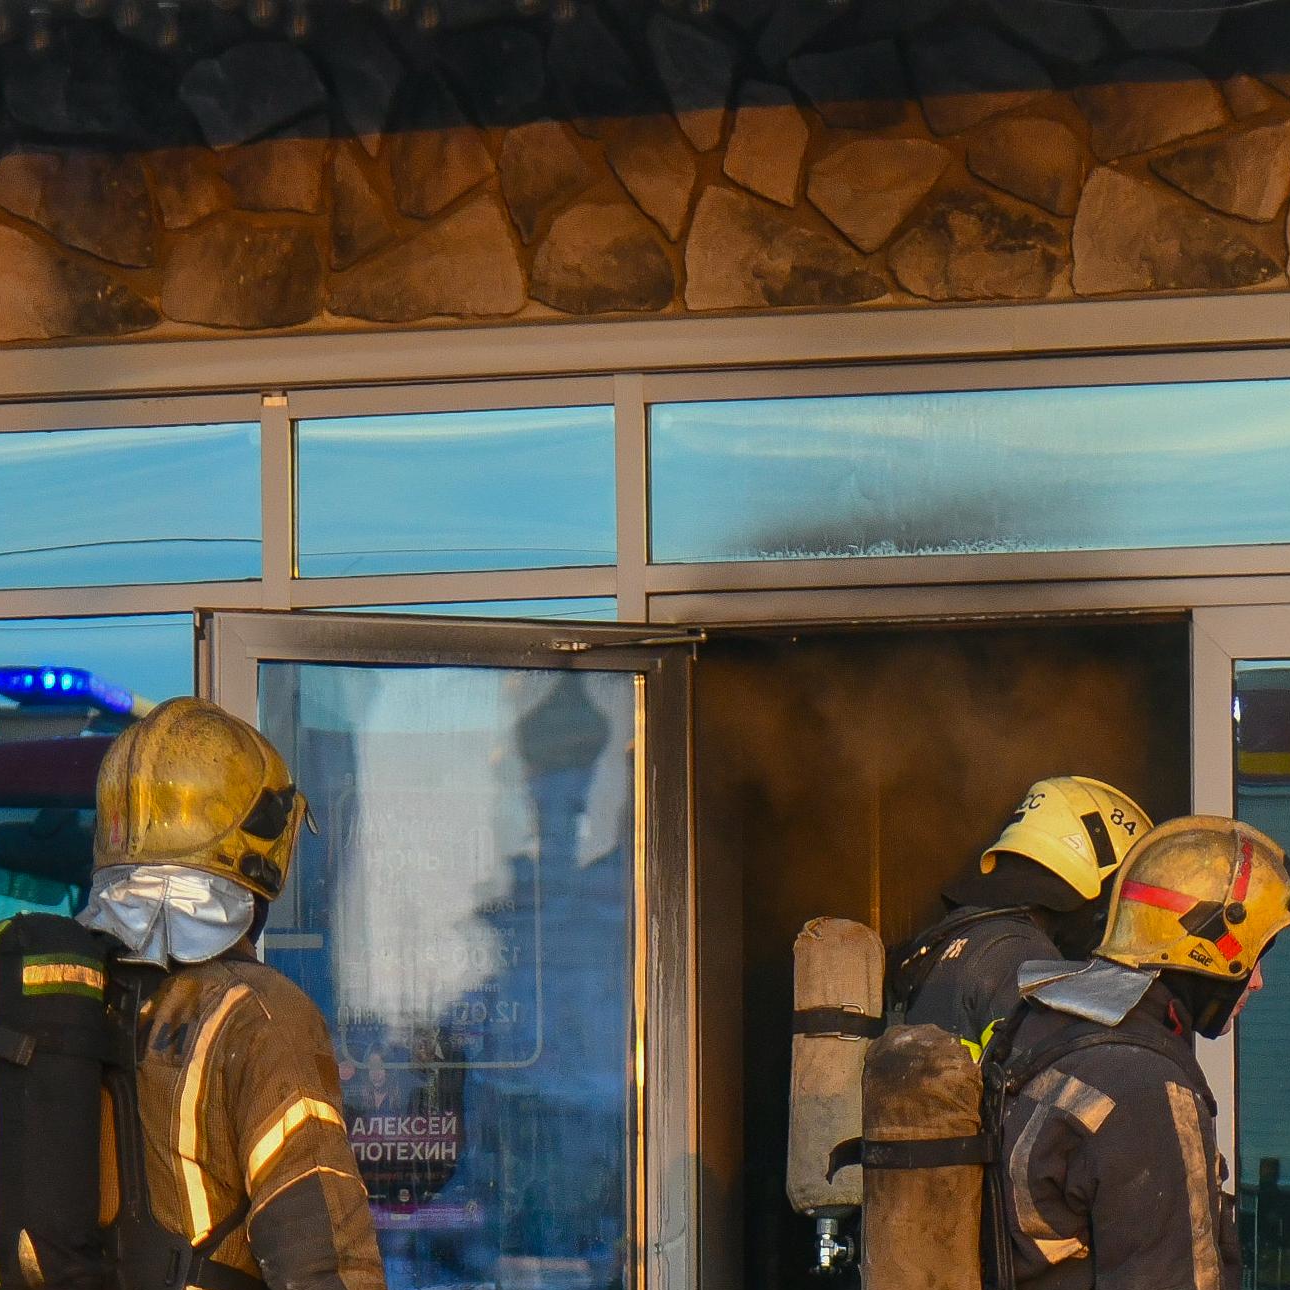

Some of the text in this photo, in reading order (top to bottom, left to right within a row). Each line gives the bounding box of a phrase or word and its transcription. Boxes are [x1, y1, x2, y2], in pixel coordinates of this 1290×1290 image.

[1109, 807, 1137, 837] 84
[351, 1111, 457, 1136] АЛЕКСЕЙ
[350, 1141, 457, 1161] ПОТЕХИН
